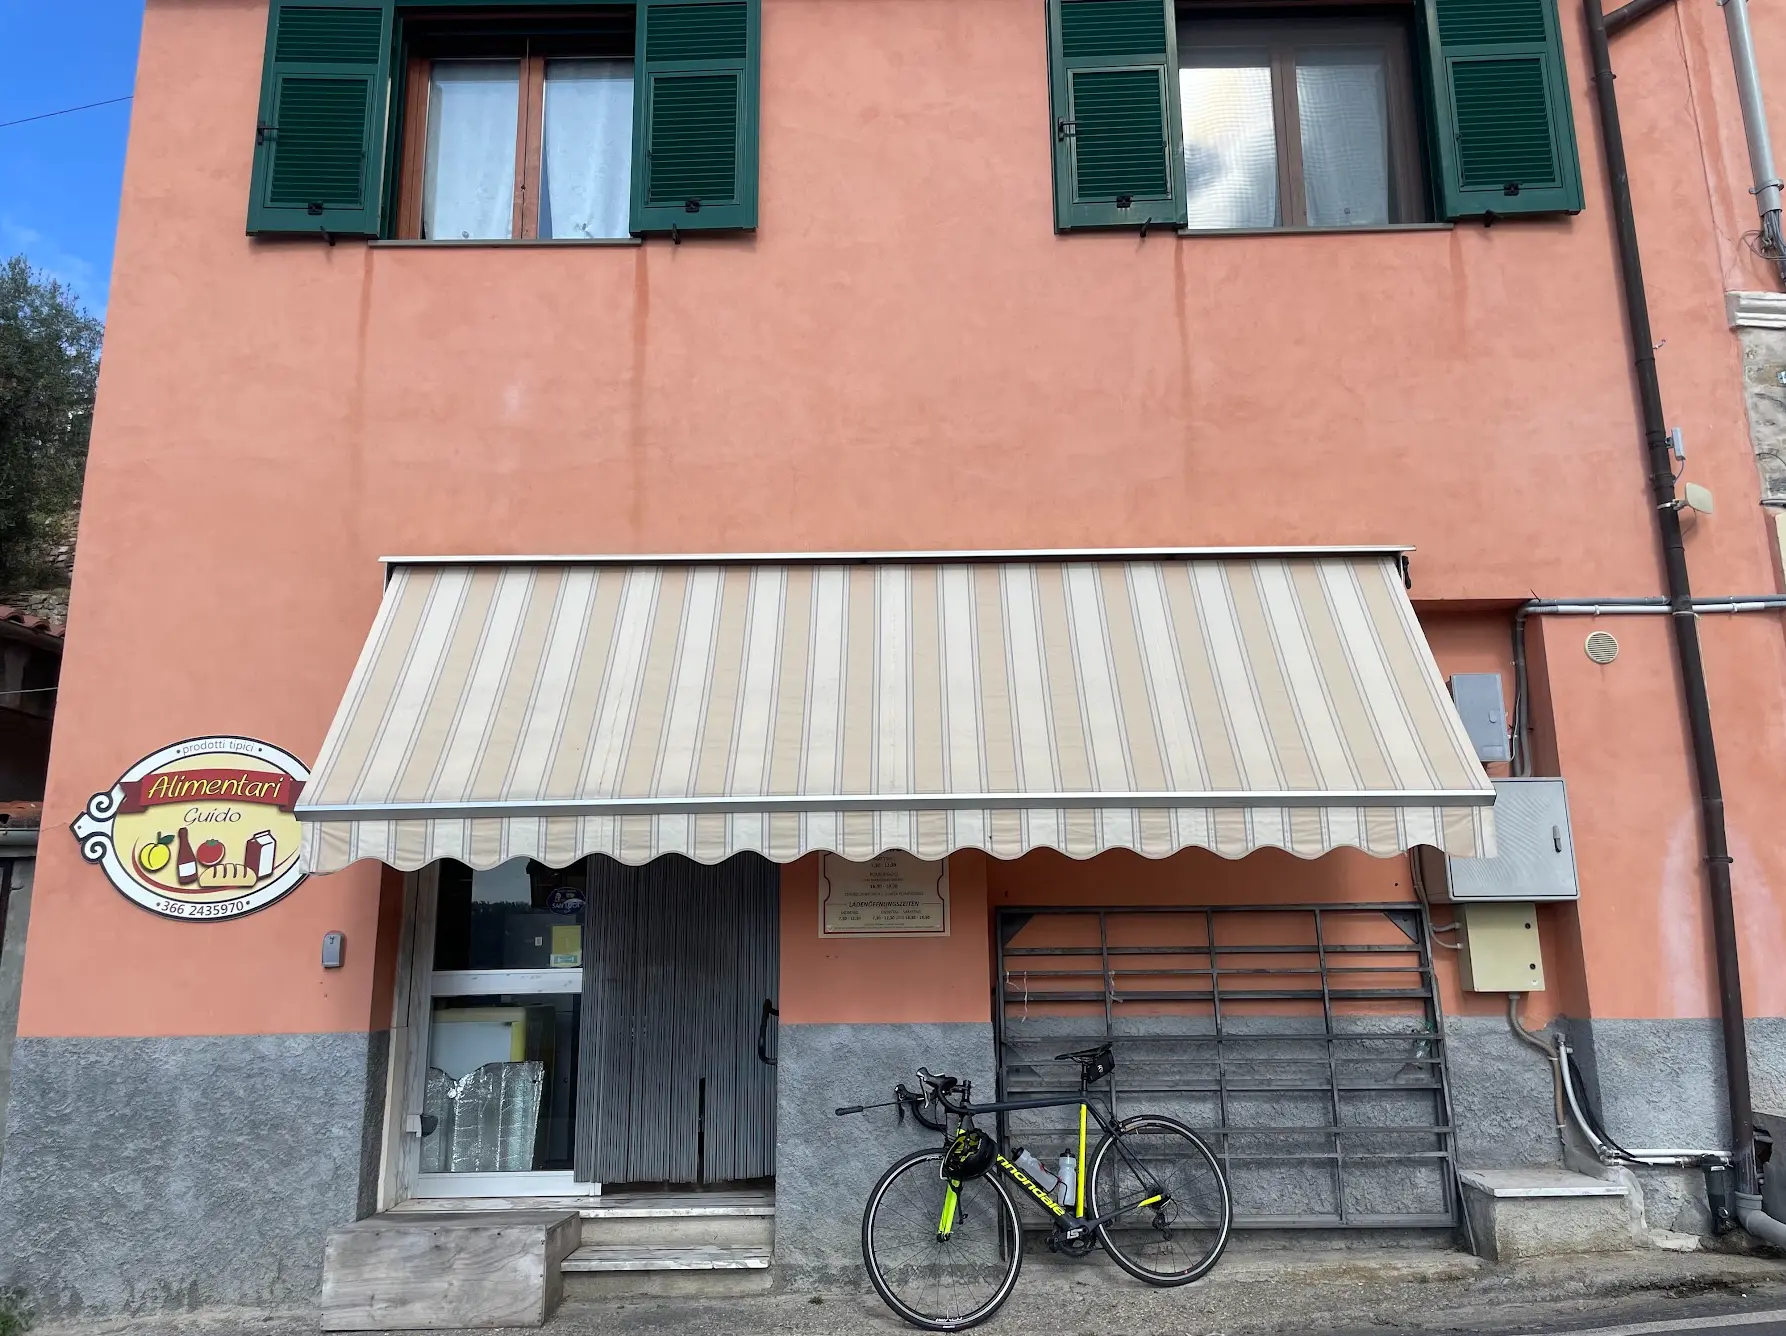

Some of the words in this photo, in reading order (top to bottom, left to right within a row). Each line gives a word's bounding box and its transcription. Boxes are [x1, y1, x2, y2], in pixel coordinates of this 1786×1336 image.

[182, 740, 225, 756] prodotti
[229, 739, 254, 753] tipici
[147, 774, 284, 799] Alimentari
[183, 807, 242, 826] Guido
[161, 900, 185, 915] 366
[188, 900, 245, 916] 2435970
[996, 1154, 1066, 1217] nnondale
